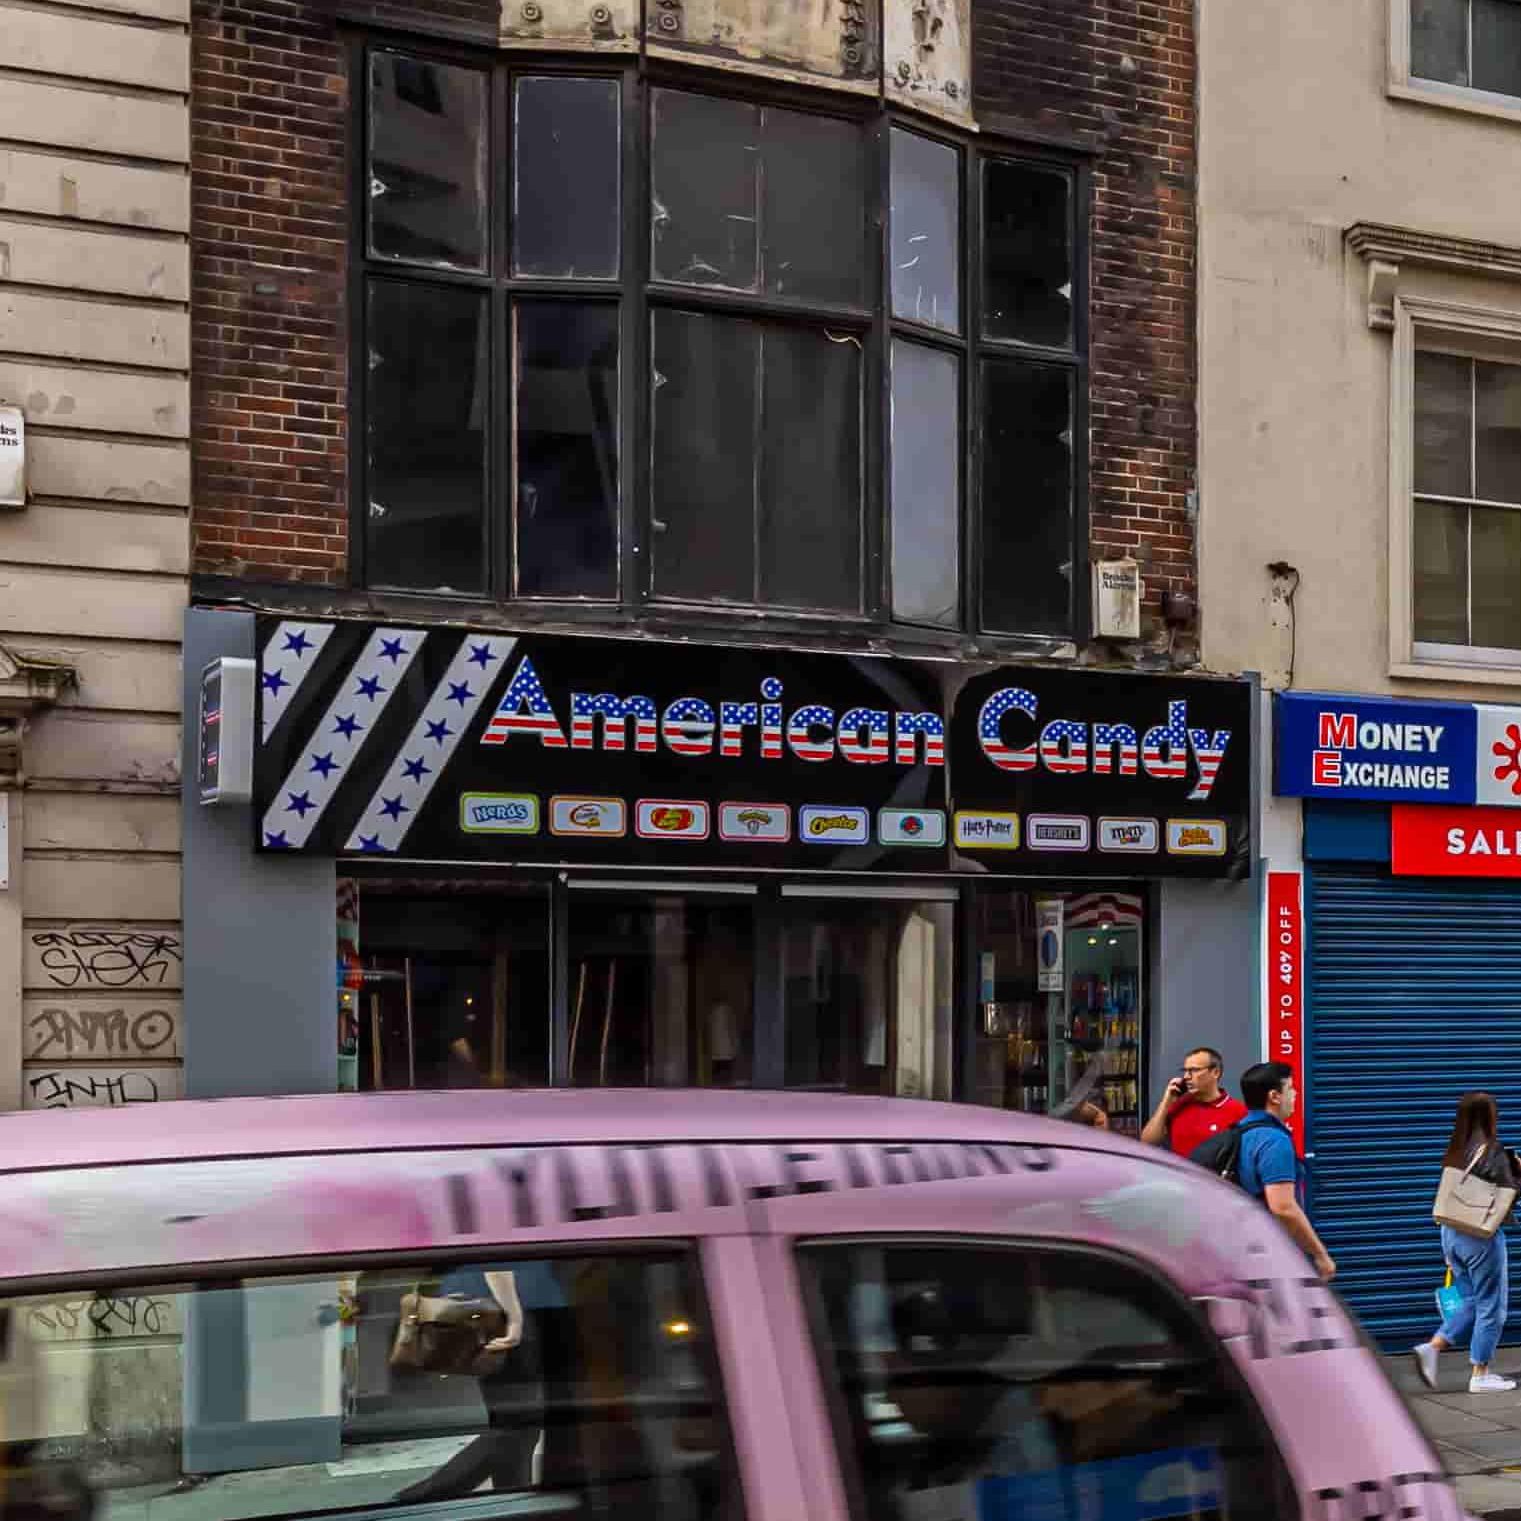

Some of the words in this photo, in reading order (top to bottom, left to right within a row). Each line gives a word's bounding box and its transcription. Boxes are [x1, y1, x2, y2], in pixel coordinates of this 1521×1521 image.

[480, 654, 945, 766] American
[977, 686, 1231, 800] Candy
[1319, 712, 1444, 753] MONEY
[1312, 751, 1449, 790] EXCHANGE
[1280, 906, 1292, 944] OFF
[1280, 994, 1293, 1019] TO
[1280, 1030, 1293, 1054] UP
